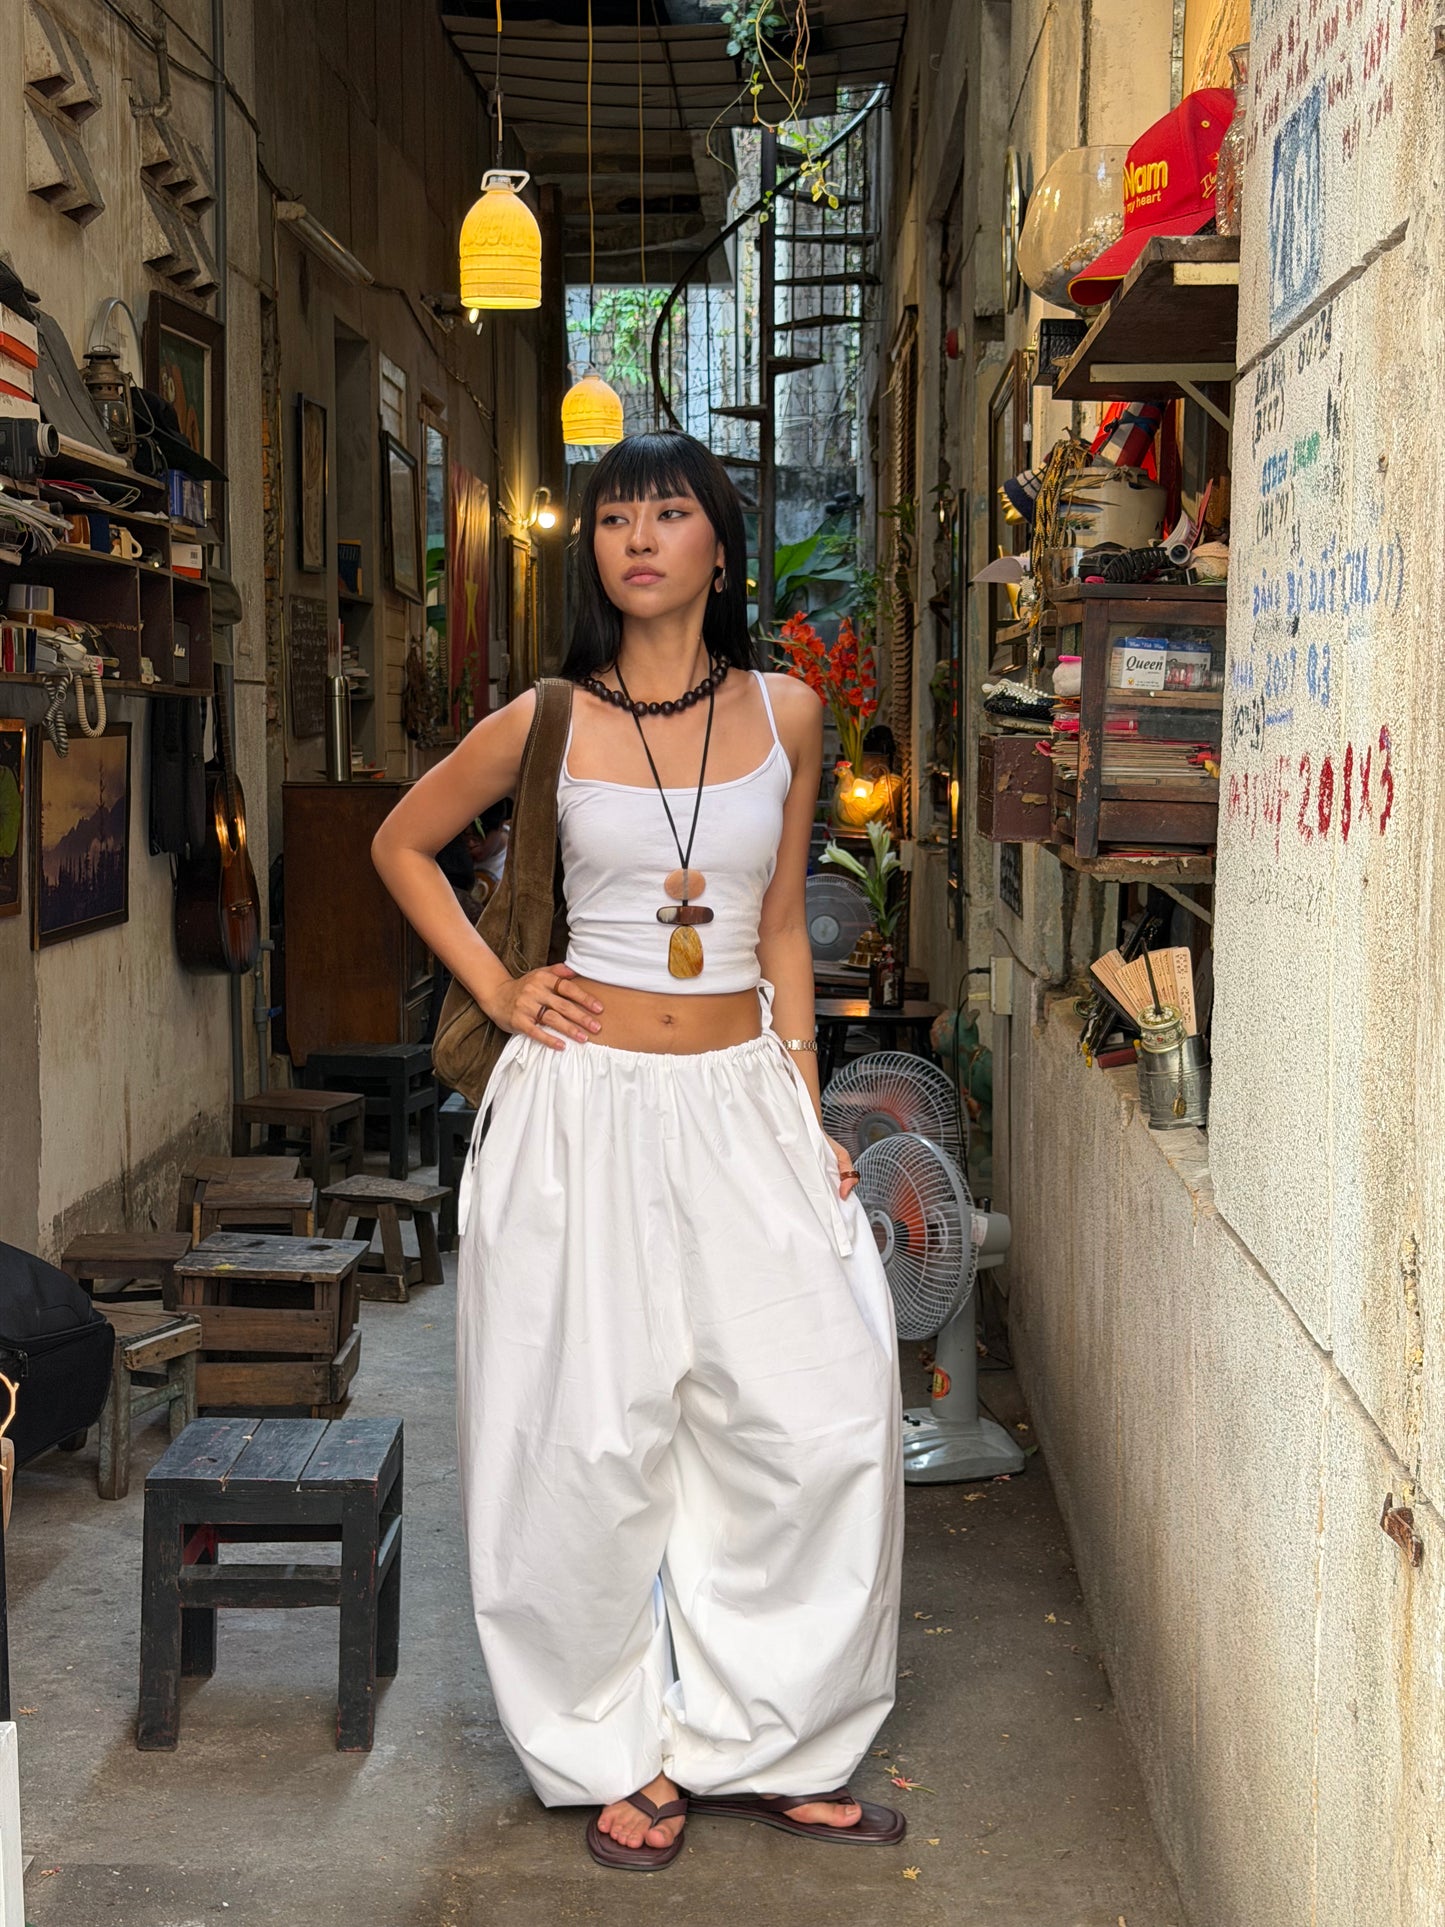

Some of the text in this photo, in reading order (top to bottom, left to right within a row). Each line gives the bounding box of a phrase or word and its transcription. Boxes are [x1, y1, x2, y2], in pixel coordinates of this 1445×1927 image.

[1123, 160, 1168, 200] Nam
[1136, 191, 1161, 208] heart
[1126, 655, 1164, 672] Queen
